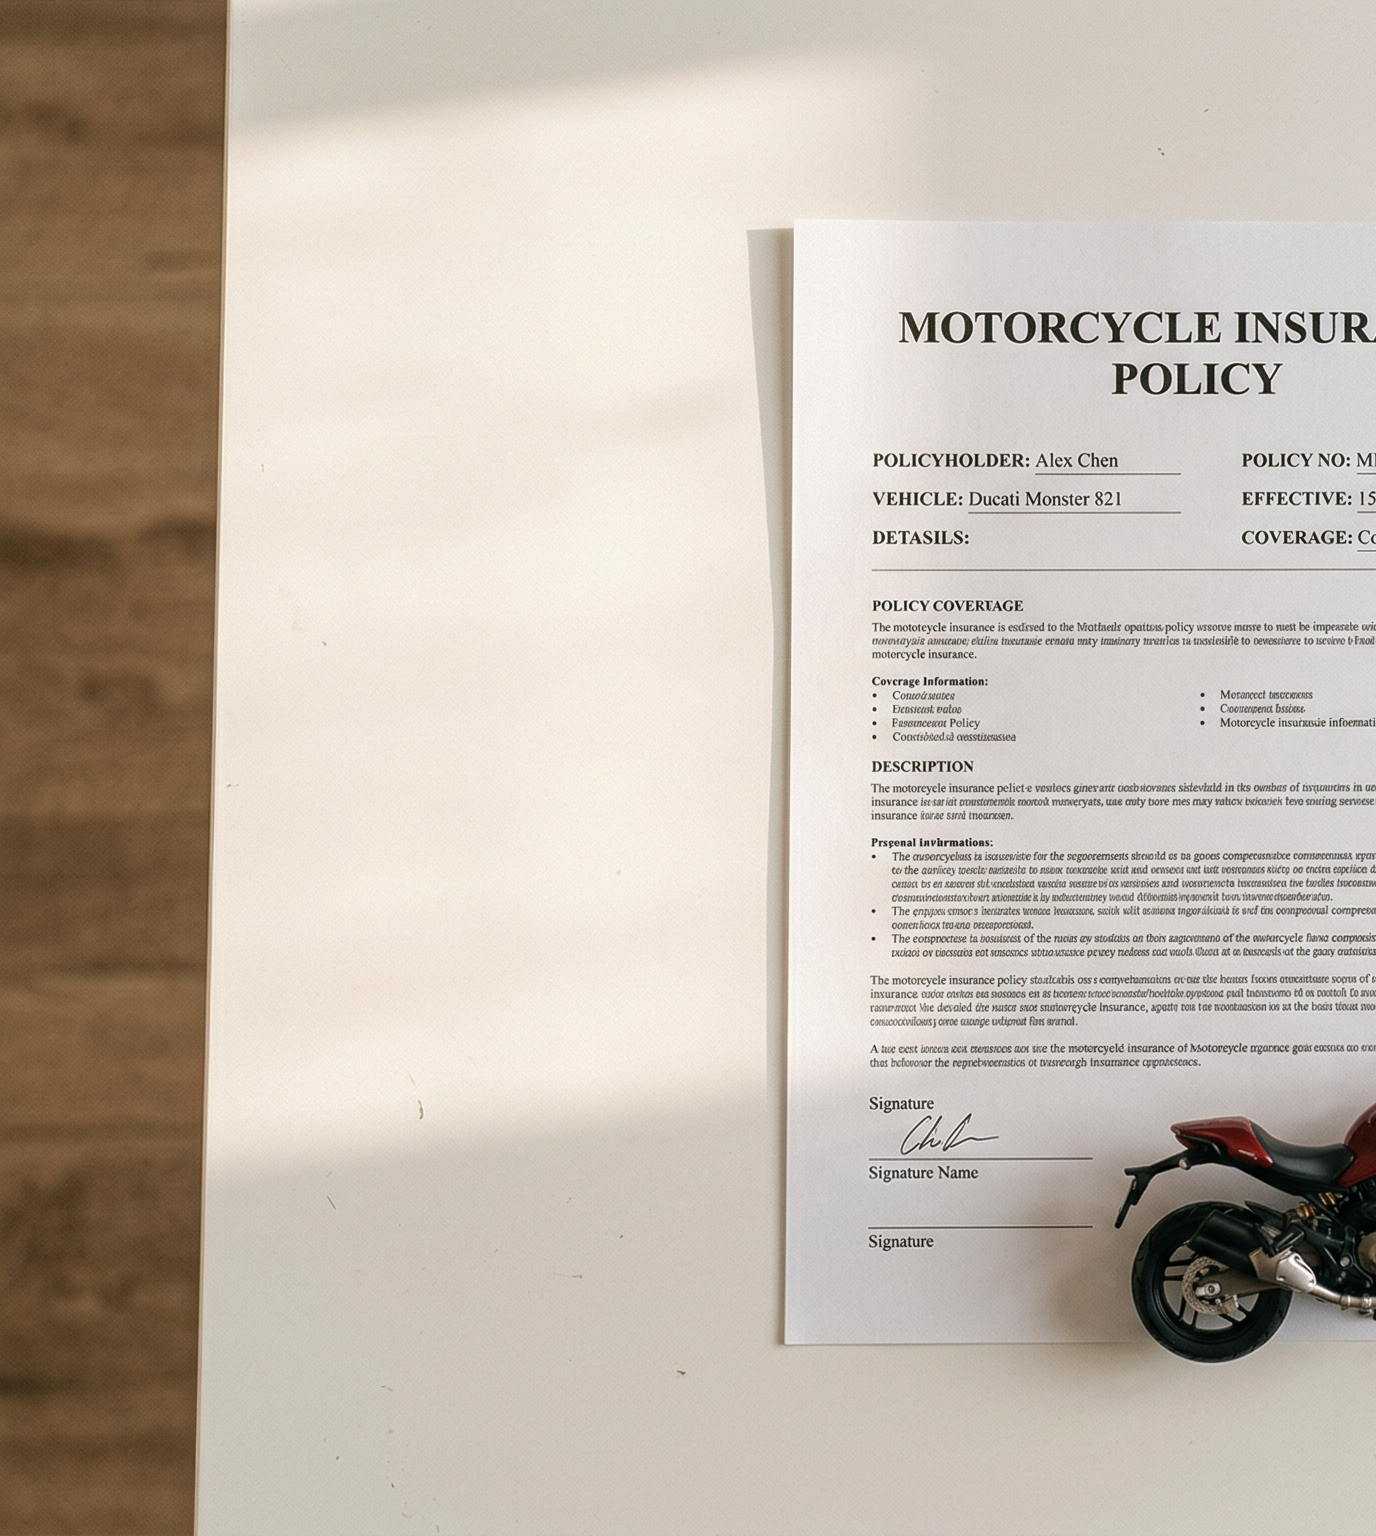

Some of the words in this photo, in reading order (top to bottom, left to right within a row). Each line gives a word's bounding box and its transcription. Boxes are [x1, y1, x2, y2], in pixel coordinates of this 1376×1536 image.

[898, 311, 1221, 344] MOTORCYCLE
[1112, 359, 1283, 395] POLICY
[873, 453, 1030, 468] POLICYHOLDER:
[1035, 453, 1073, 471] Alex
[1078, 452, 1118, 468] Chen
[1242, 453, 1313, 468] POLICY
[1318, 453, 1350, 467] NO:
[873, 492, 963, 506] VEHICLE:
[969, 491, 1020, 506] Ducati
[1025, 491, 1090, 506] Monster
[1095, 491, 1121, 506] 821
[1242, 491, 1352, 506] EFFECTIVE:
[872, 530, 969, 545] DETASILS:
[1242, 530, 1352, 545] COVERAGE:
[873, 600, 930, 612] POLICY
[872, 622, 891, 632] The
[950, 622, 995, 632] insurance
[998, 622, 1006, 632] is
[1047, 623, 1057, 632] to
[1059, 622, 1074, 632] the
[1165, 622, 1194, 634] policy
[1264, 623, 1273, 631] to
[1241, 637, 1250, 645] to
[1304, 637, 1314, 645] to
[929, 649, 977, 659] insurance.
[923, 677, 988, 686] Information:
[872, 760, 974, 772] DESCRIPTION
[871, 783, 890, 793] The
[949, 783, 994, 793] insurance
[872, 797, 918, 806] insurance
[871, 810, 917, 820] insurance
[892, 852, 910, 861] The
[1050, 851, 1064, 861] the
[891, 906, 910, 916] The
[891, 934, 910, 943] The
[1037, 933, 1051, 943] the
[1235, 933, 1250, 942] the
[1296, 946, 1310, 956] the
[949, 975, 995, 985] insurance
[870, 1044, 879, 1053] A
[1050, 1043, 1065, 1053] the
[1177, 1043, 1188, 1053] of
[935, 1057, 949, 1067] the
[869, 1096, 934, 1115] Signature
[869, 1164, 935, 1183] Signature
[937, 1164, 979, 1179] Name
[869, 1235, 934, 1252] Signature
